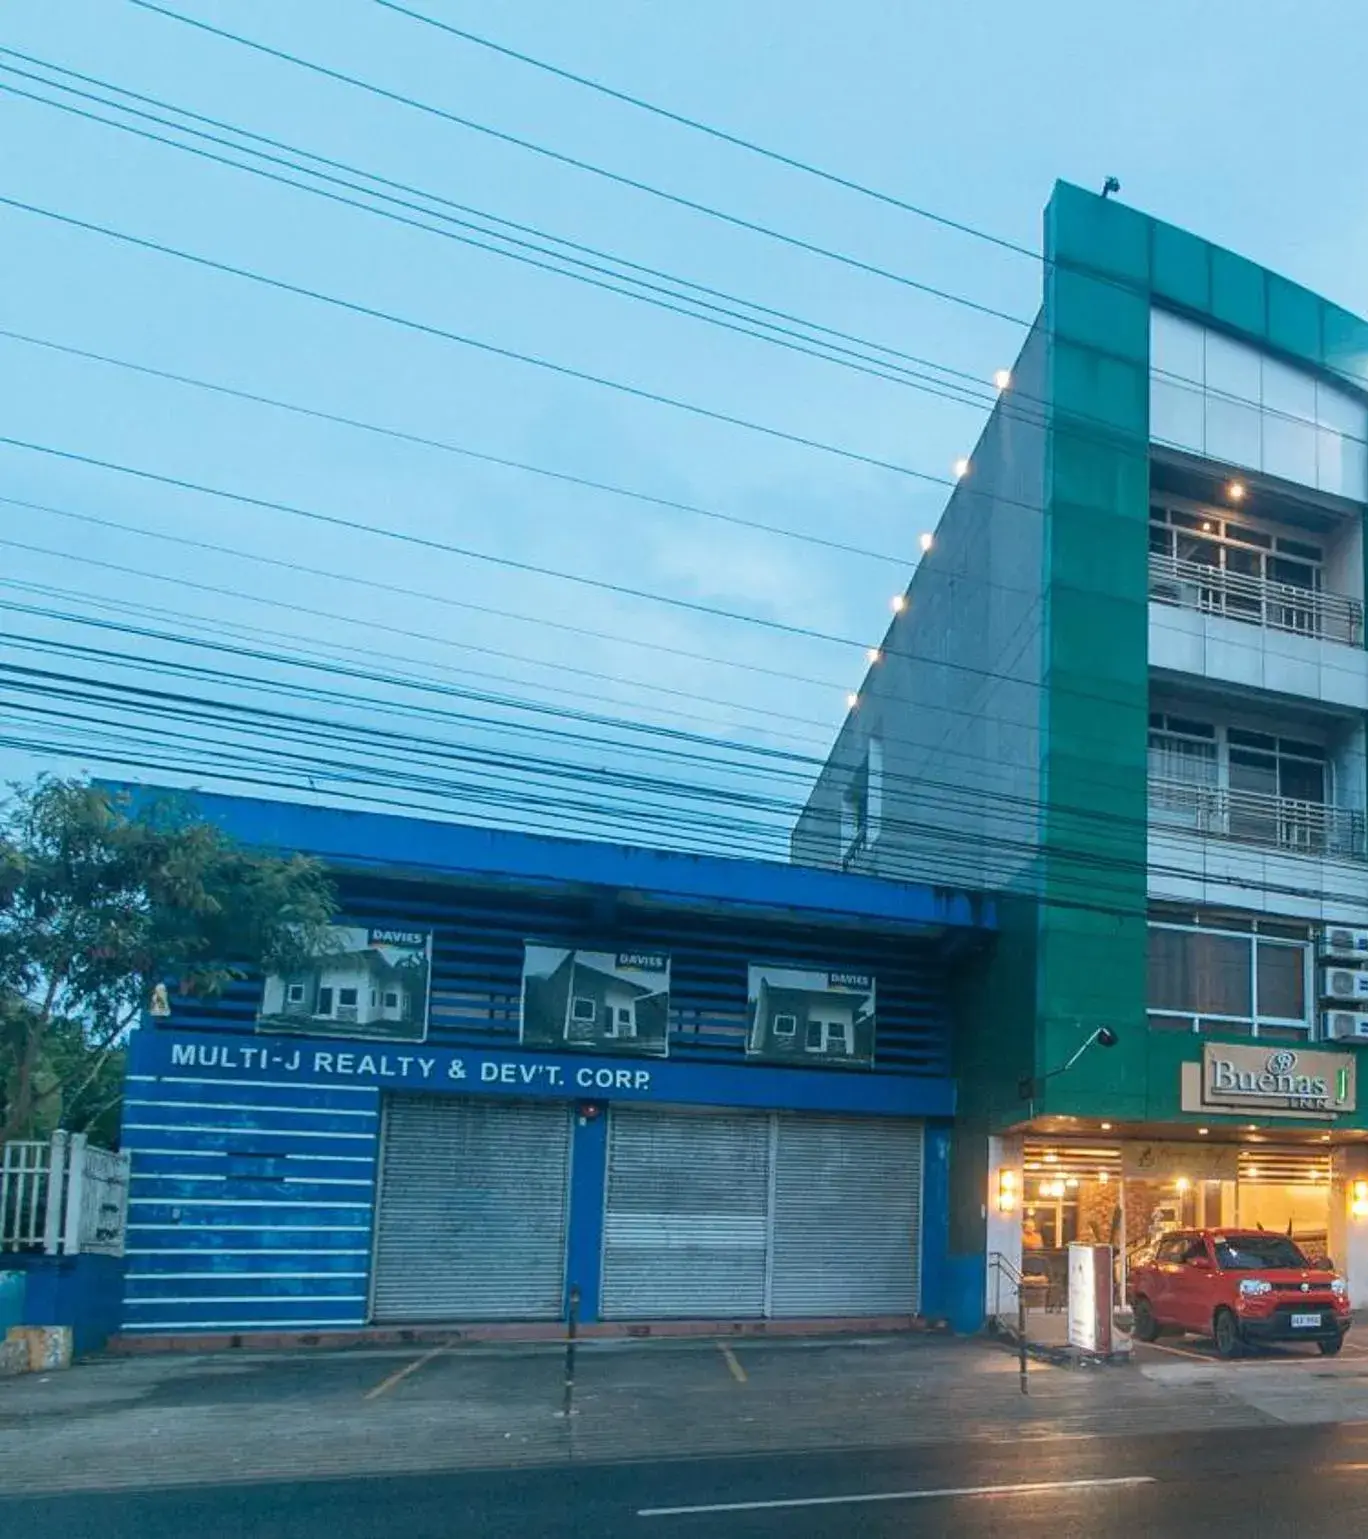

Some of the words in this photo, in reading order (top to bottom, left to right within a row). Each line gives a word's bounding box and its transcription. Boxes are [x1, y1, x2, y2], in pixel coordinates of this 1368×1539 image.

[373, 929, 422, 943] DAVIES
[620, 953, 663, 967] DAVIES
[831, 973, 869, 985] DAVIES
[171, 1043, 300, 1071] MULTI-J
[313, 1052, 435, 1079] REALTY
[448, 1059, 467, 1079] &
[481, 1062, 564, 1086] DEV'T.
[576, 1068, 650, 1090] CORP.
[1213, 1060, 1328, 1096] Buenas
